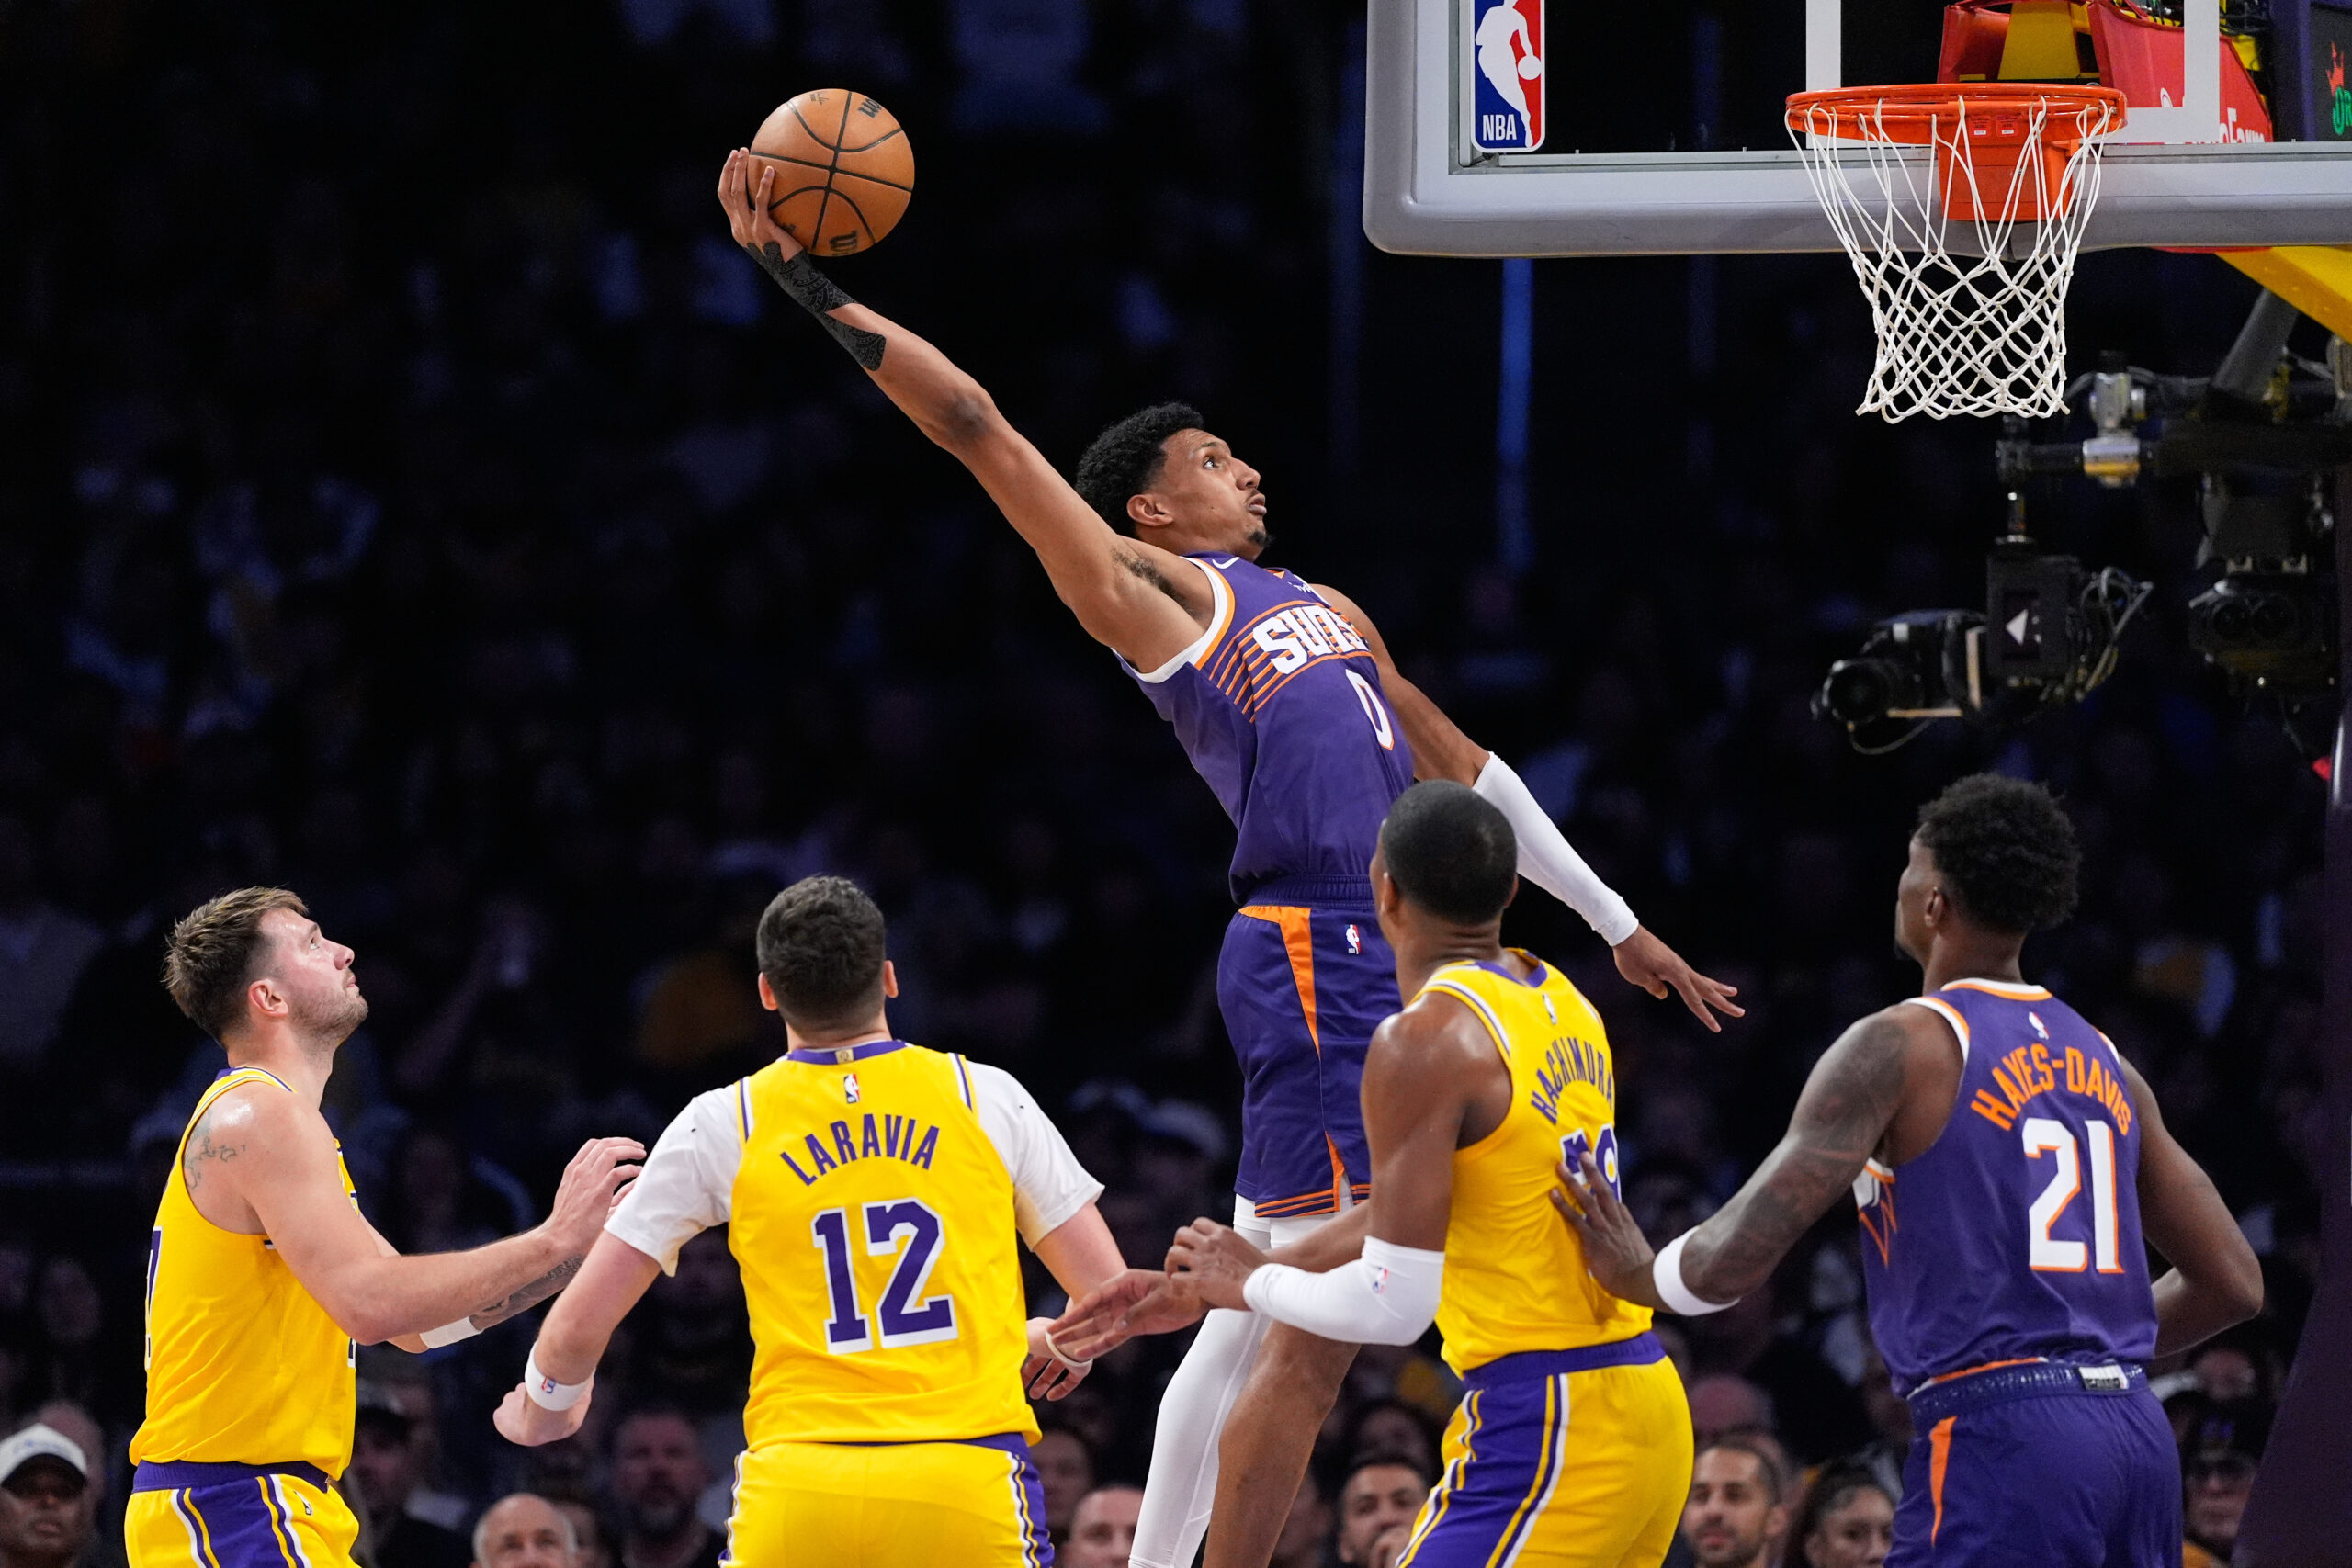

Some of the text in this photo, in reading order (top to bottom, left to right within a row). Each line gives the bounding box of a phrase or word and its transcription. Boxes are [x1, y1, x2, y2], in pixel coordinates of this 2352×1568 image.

[1482, 114, 1517, 141] NBA
[1252, 604, 1371, 675] SUNS
[1345, 668, 1395, 750] 0
[1531, 1036, 1613, 1126] HACHIMURA
[1971, 1043, 2133, 1136] HAYES-DAVIS
[779, 1113, 941, 1188] LARAVIA
[2021, 1117, 2125, 1274] 21
[810, 1196, 959, 1356] 12
